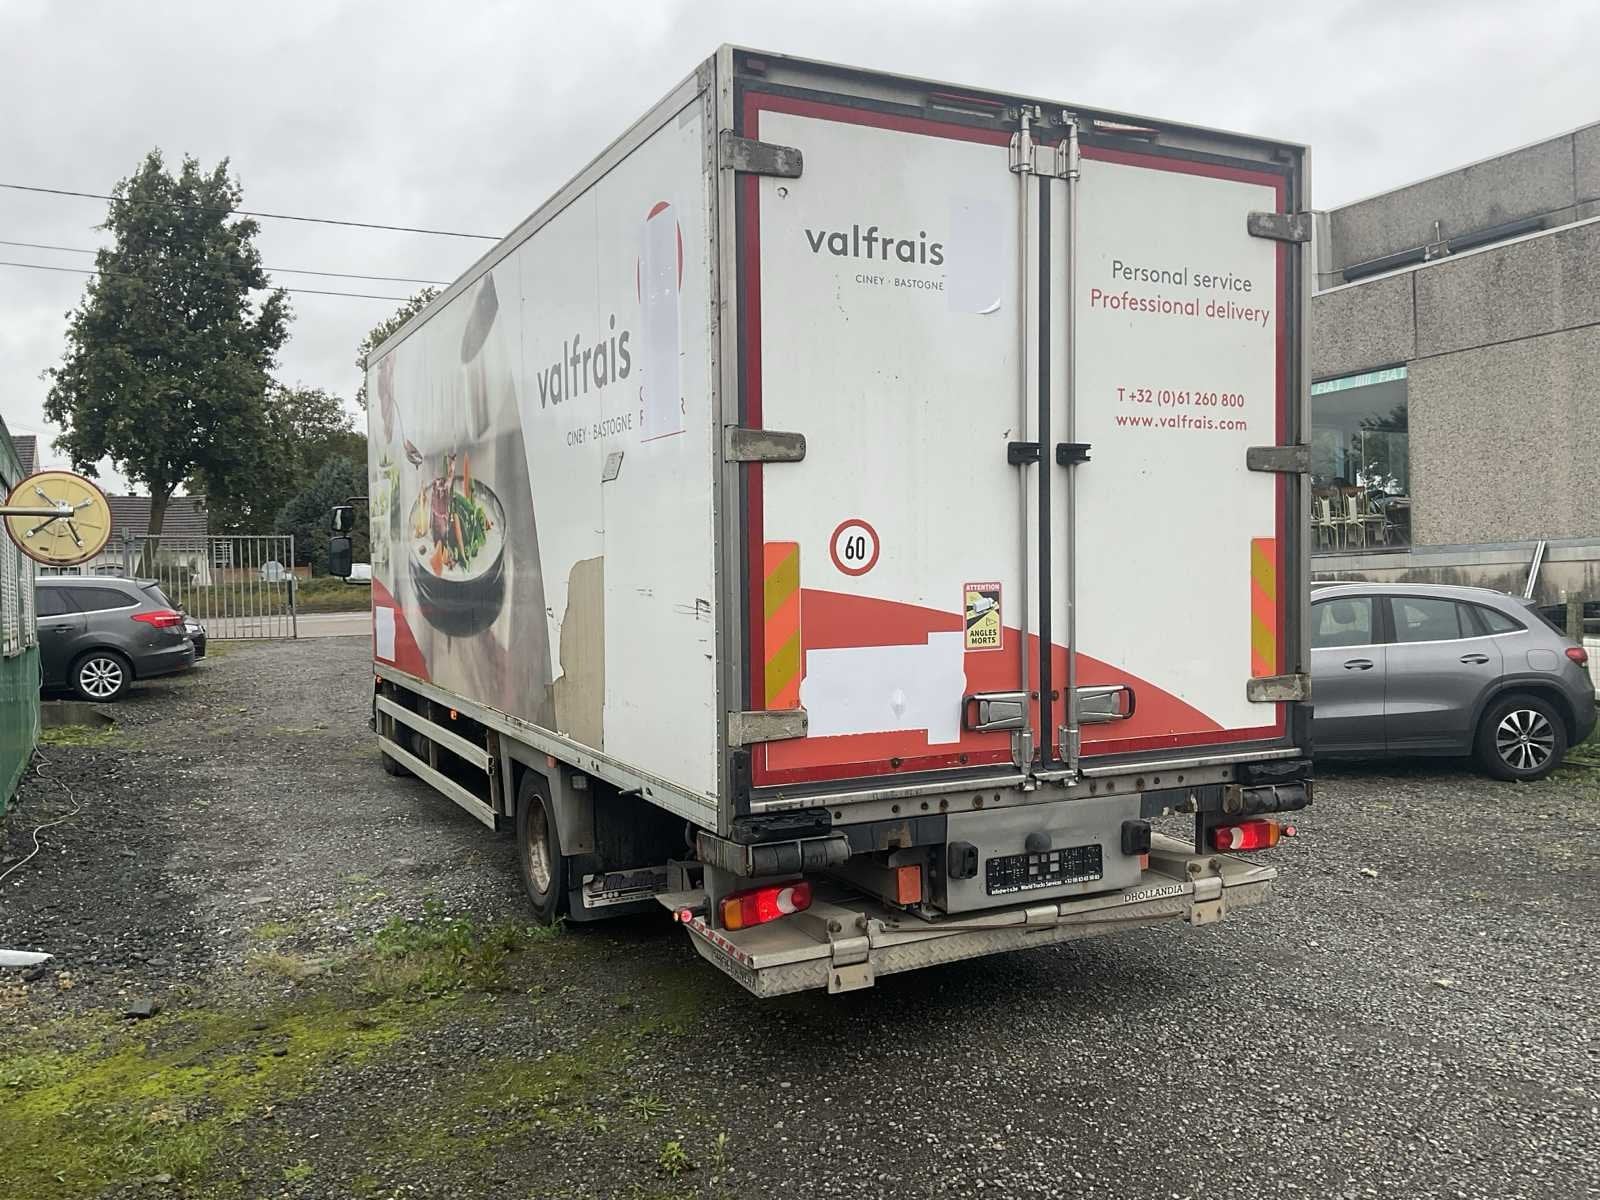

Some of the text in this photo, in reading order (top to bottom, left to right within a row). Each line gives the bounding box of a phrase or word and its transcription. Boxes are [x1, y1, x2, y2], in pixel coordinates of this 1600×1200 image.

[805, 224, 944, 266] valfrais
[855, 274, 944, 291] CINEY BASTOGNE
[1112, 260, 1252, 292] Personal service
[1090, 288, 1270, 328] Professional delivery
[537, 313, 631, 409] valfrais
[1117, 388, 1245, 408] T +32 (0)61 260 800
[566, 427, 587, 447] CINEY
[593, 413, 633, 440] BASTOGNE
[1116, 414, 1247, 431] www.valfrais.com
[845, 535, 865, 560] 60
[965, 583, 1000, 592] ATTENTION
[970, 629, 997, 637] ANGLES
[971, 636, 996, 645] MORTS
[1124, 884, 1184, 903] DHOLLANDIA
